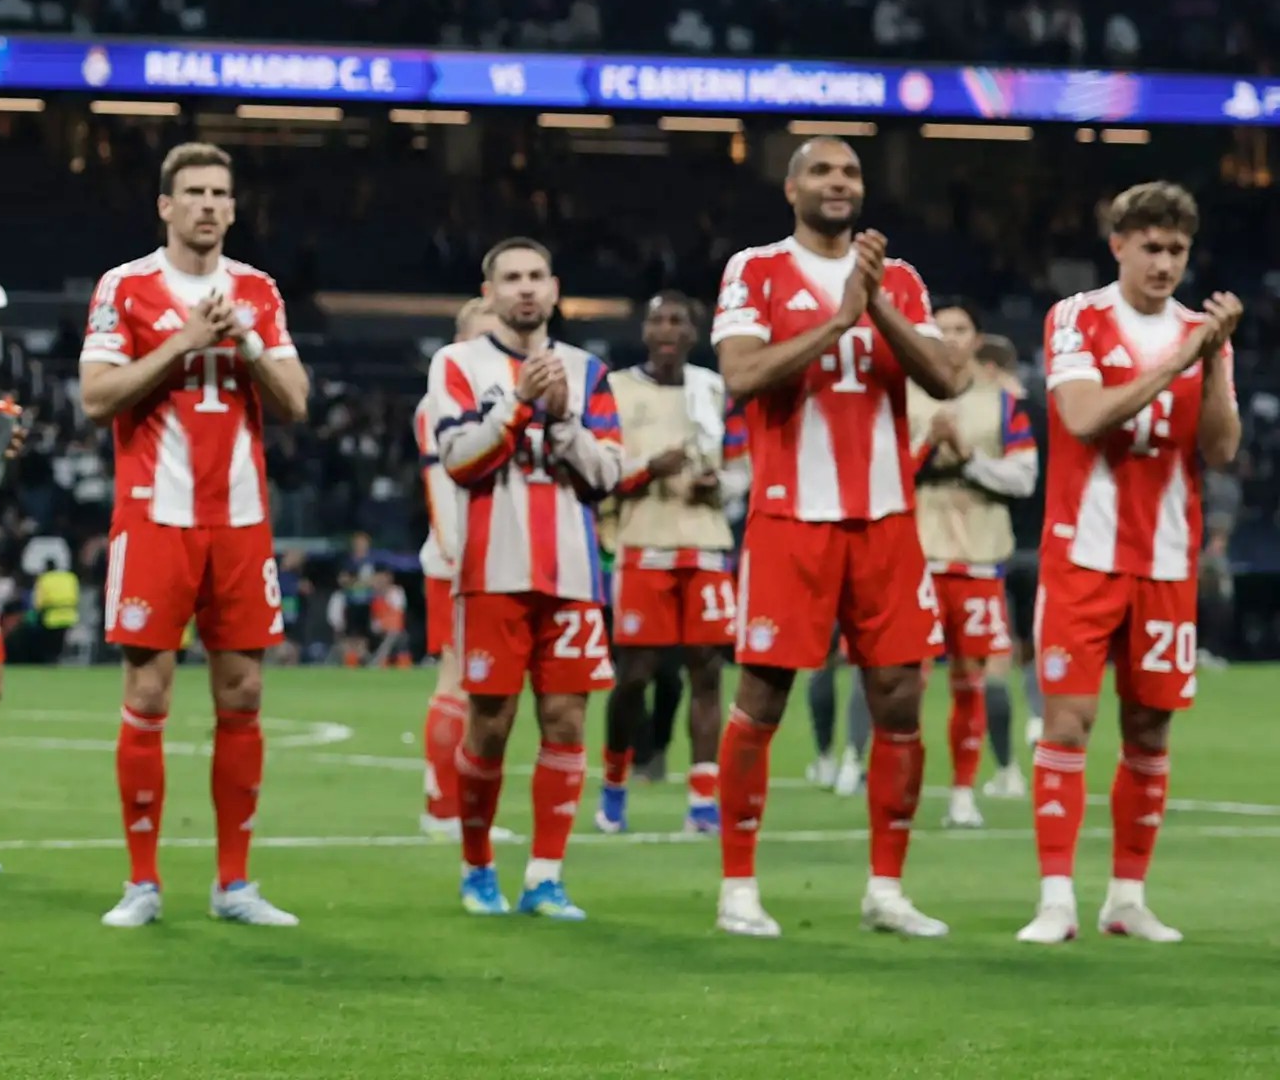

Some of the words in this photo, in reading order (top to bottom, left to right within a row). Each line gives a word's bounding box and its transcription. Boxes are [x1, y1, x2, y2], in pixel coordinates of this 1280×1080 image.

[144, 50, 219, 86] REAL
[221, 53, 337, 90] MADRID
[599, 64, 638, 100] FC
[638, 66, 745, 102] BAYERN
[748, 62, 886, 107] MÜNCHEN
[700, 580, 738, 621] 11
[963, 595, 1007, 636] 21
[553, 607, 608, 659] 22
[1142, 620, 1197, 674] 20
